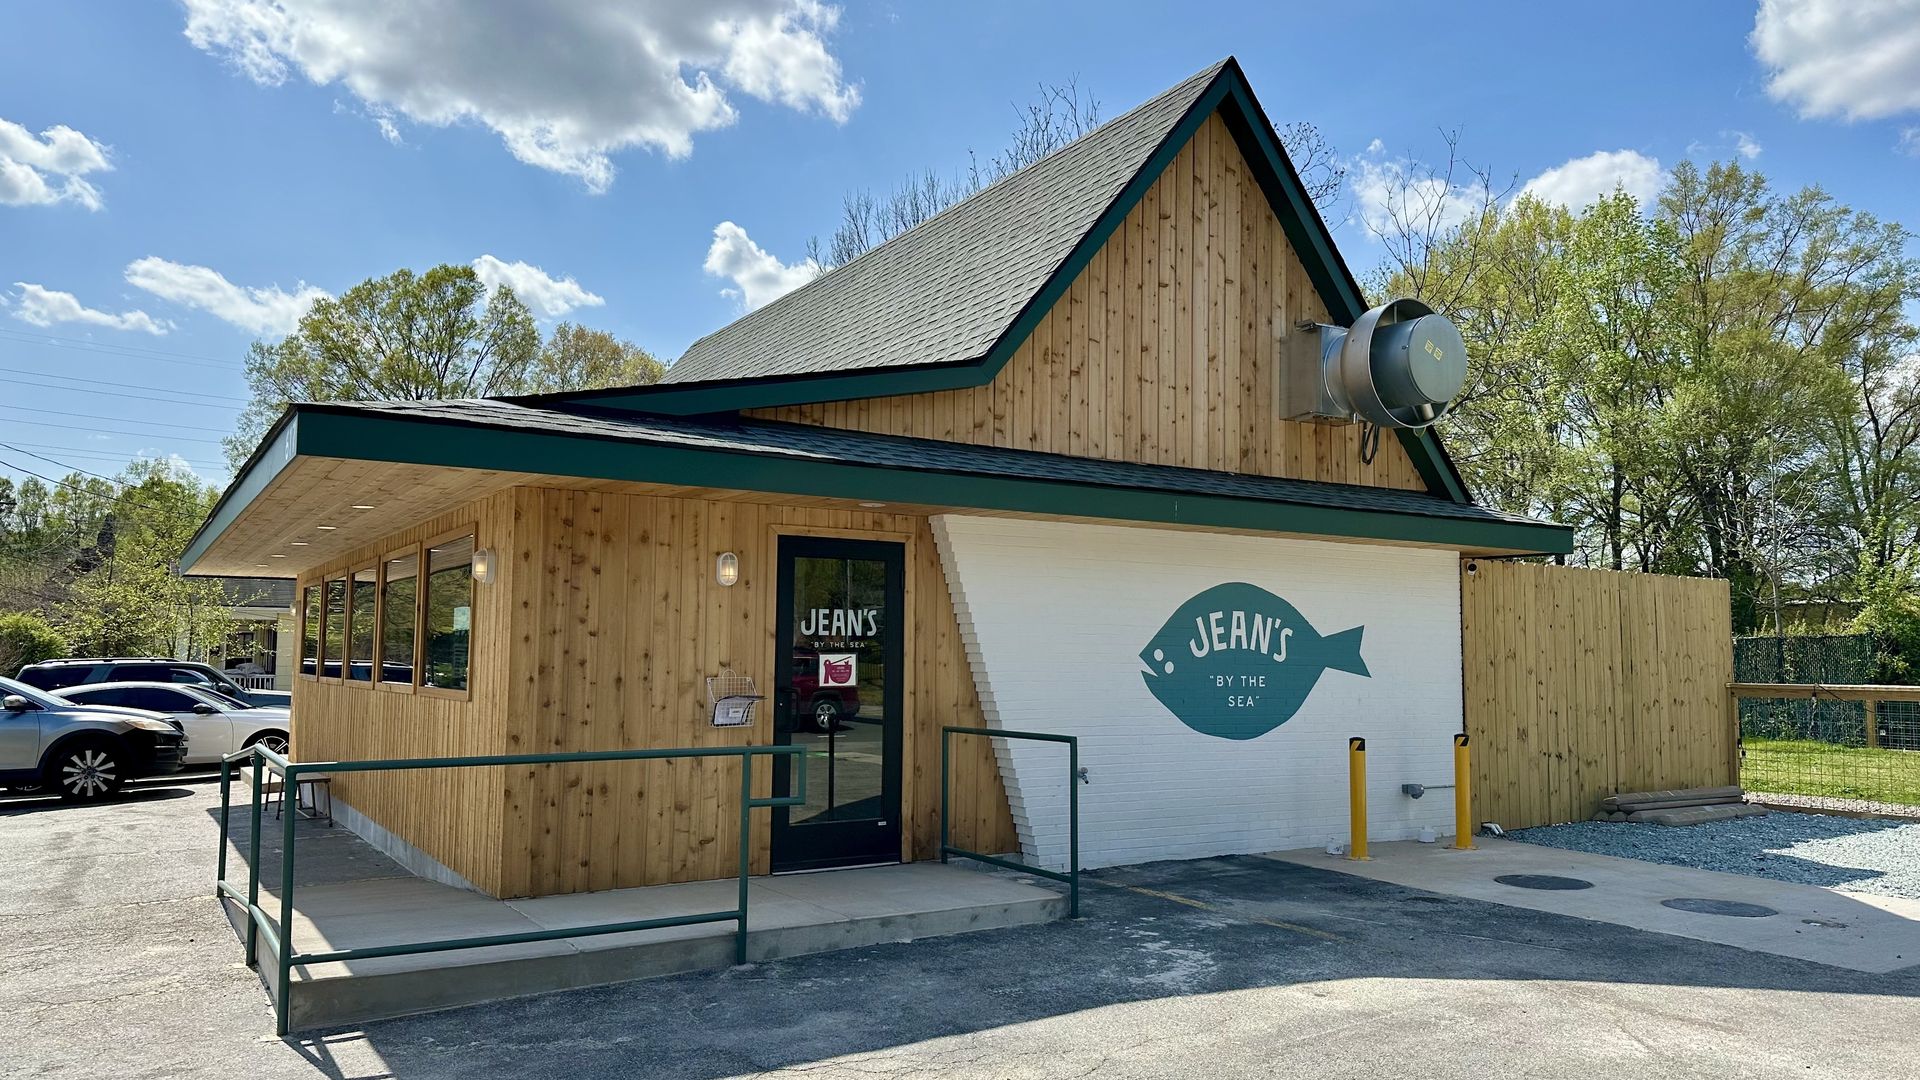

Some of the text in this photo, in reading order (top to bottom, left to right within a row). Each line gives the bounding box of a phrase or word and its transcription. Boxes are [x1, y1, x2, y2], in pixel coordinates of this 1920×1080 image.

[800, 608, 877, 636] JEAN'S
[1189, 610, 1293, 663] JEAN'S
[1209, 675, 1266, 687] "BY THE
[1228, 695, 1260, 707] SEA"
